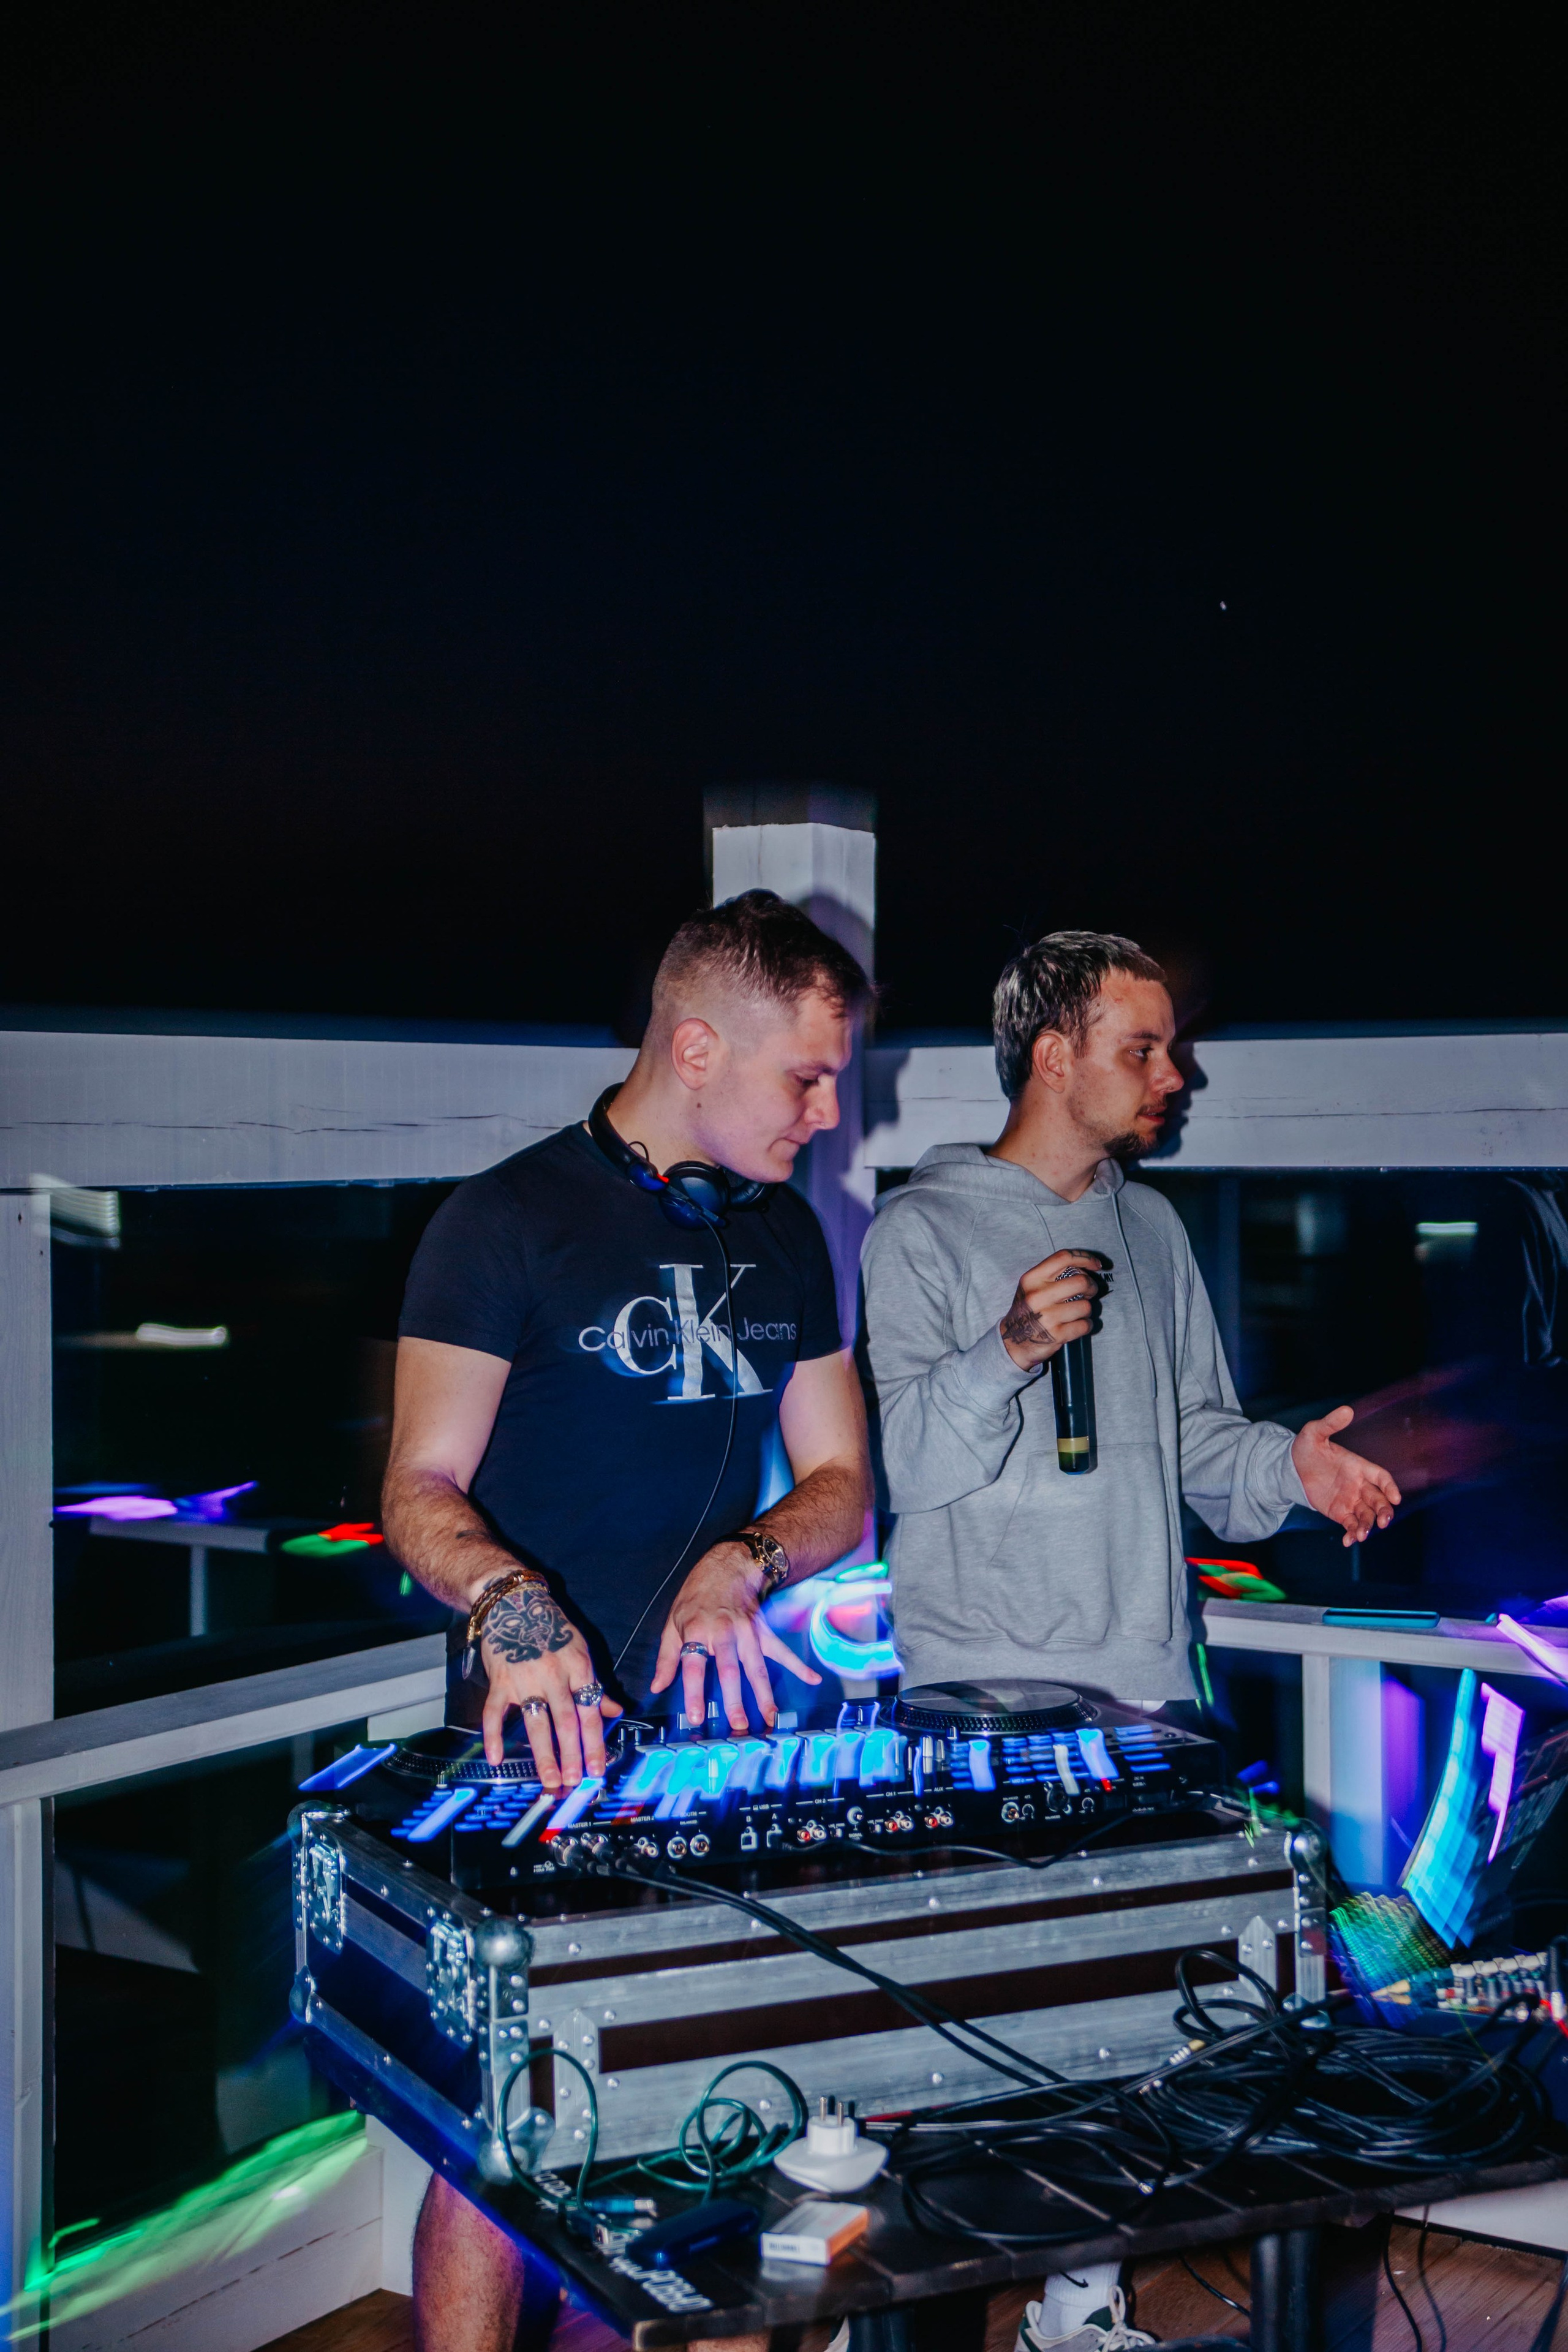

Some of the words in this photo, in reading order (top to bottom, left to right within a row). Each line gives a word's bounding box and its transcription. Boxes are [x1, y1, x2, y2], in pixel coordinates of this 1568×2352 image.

[578, 1323, 669, 1352] Calvin
[674, 1319, 731, 1345] Klein
[737, 1317, 796, 1341] Jeans
[613, 1264, 773, 1400] CK
